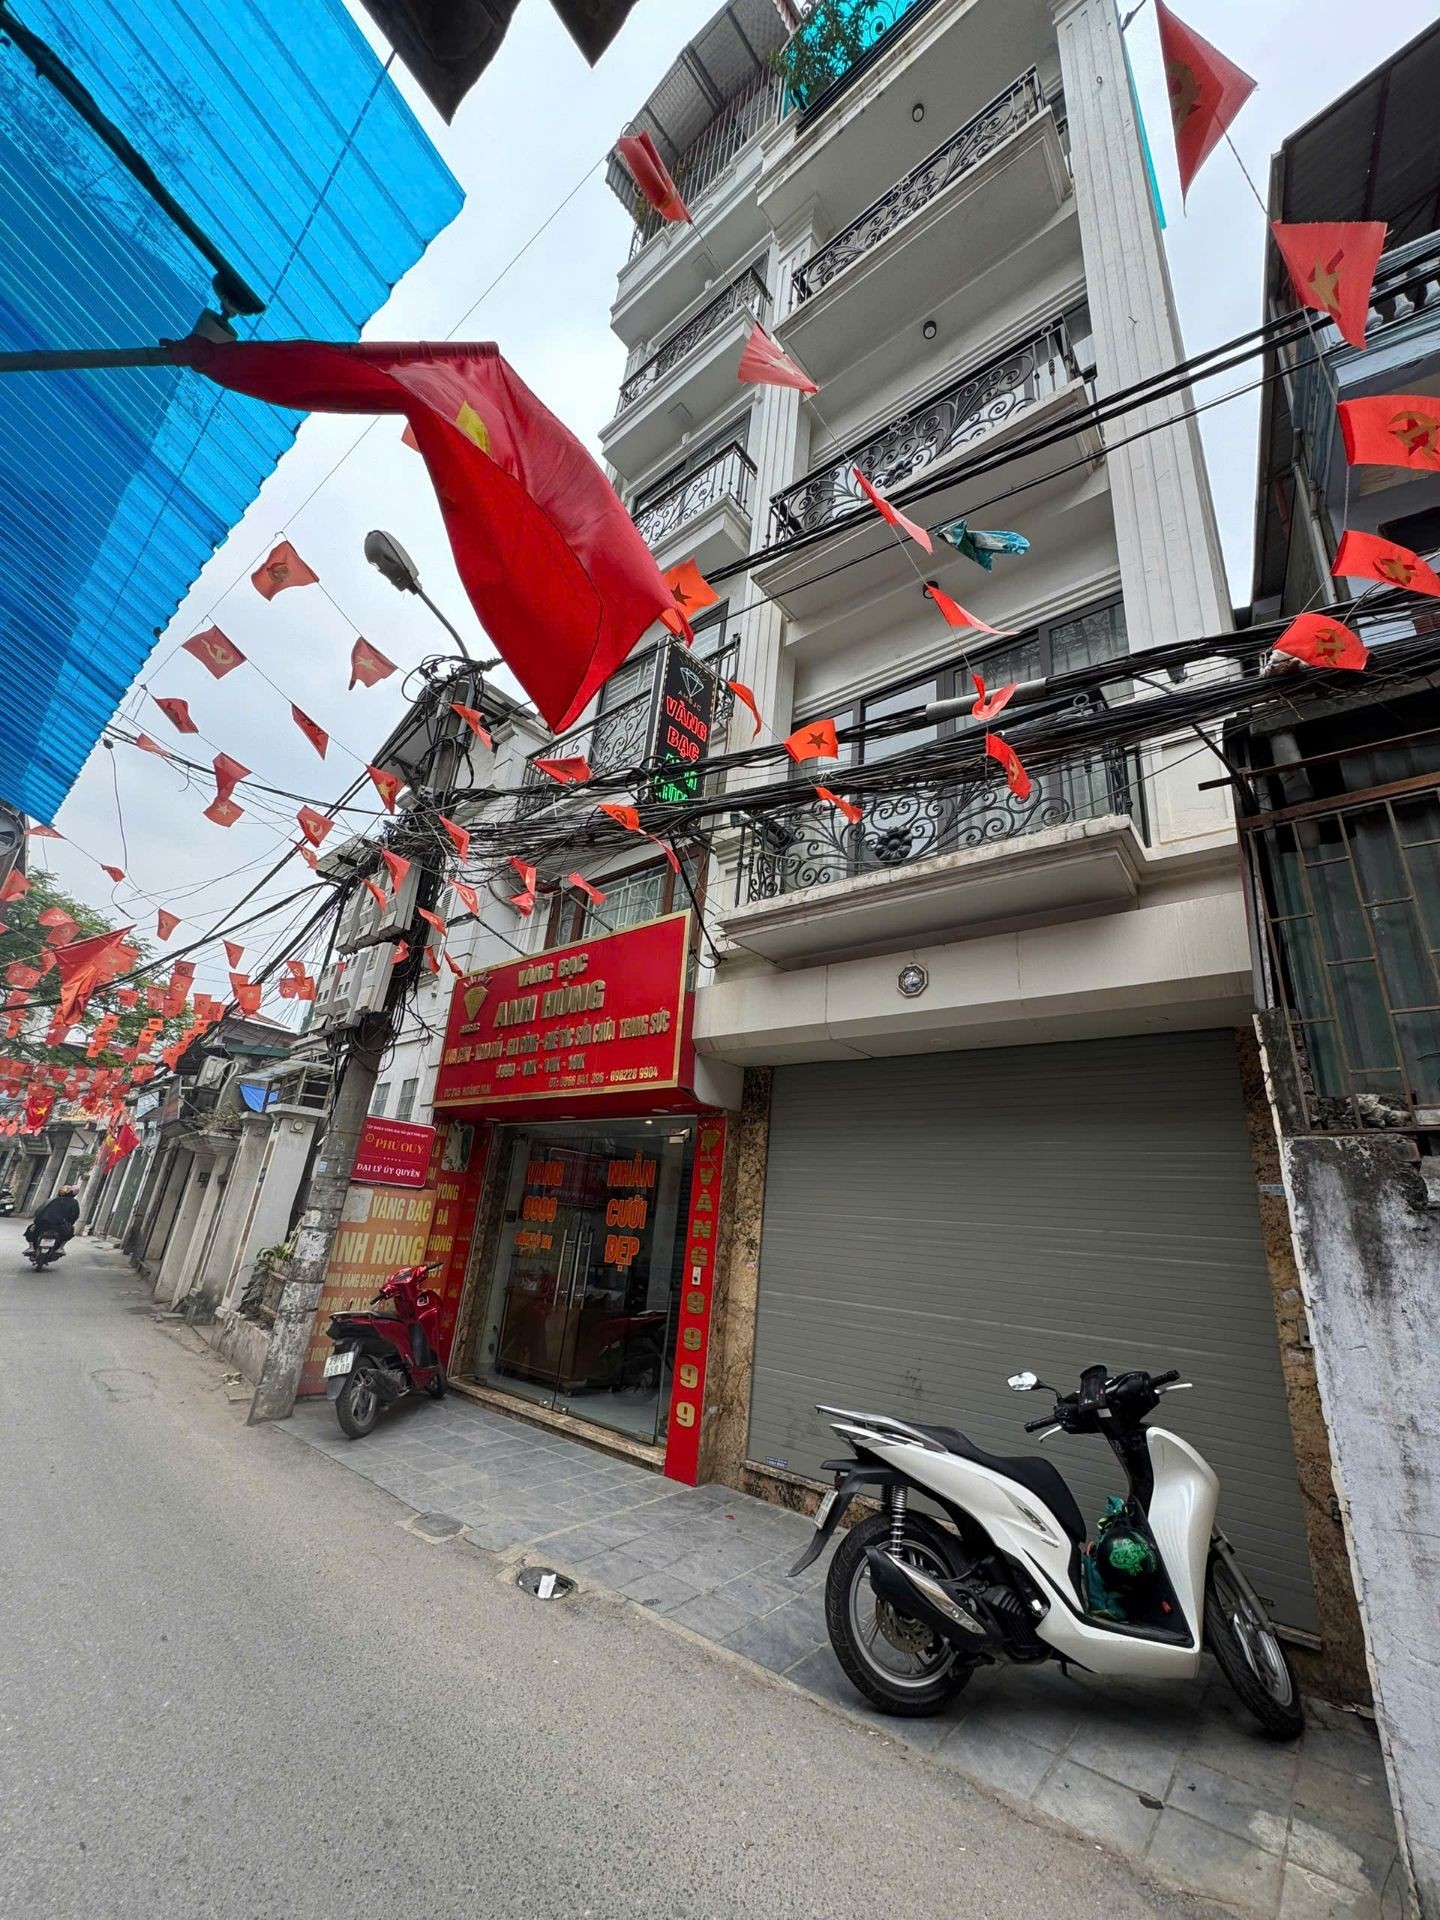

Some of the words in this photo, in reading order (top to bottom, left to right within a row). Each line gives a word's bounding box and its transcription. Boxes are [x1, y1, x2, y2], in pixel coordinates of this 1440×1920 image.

[666, 696, 708, 742] VÀNG
[667, 725, 700, 761] BẠC
[518, 963, 554, 987] VÀNG
[557, 953, 589, 979] BẠC
[493, 995, 538, 1028] ANH
[541, 980, 606, 1019] HÙNG
[592, 1017, 615, 1043] CHỮA
[619, 1015, 650, 1039] TRANG
[649, 1007, 671, 1034] SỨC
[356, 1163, 372, 1172] ĐẠI
[372, 1164, 383, 1173] LÝ
[395, 1167, 421, 1178] QUYỀN
[527, 1157, 564, 1186] VÀNG
[372, 1192, 406, 1220] VÀNG
[406, 1198, 432, 1227] BẠC
[606, 1195, 647, 1229] CƯỚI
[691, 1168, 714, 1267] VÀNG
[370, 1228, 425, 1266] HÙNG
[604, 1234, 640, 1272] ĐẸP
